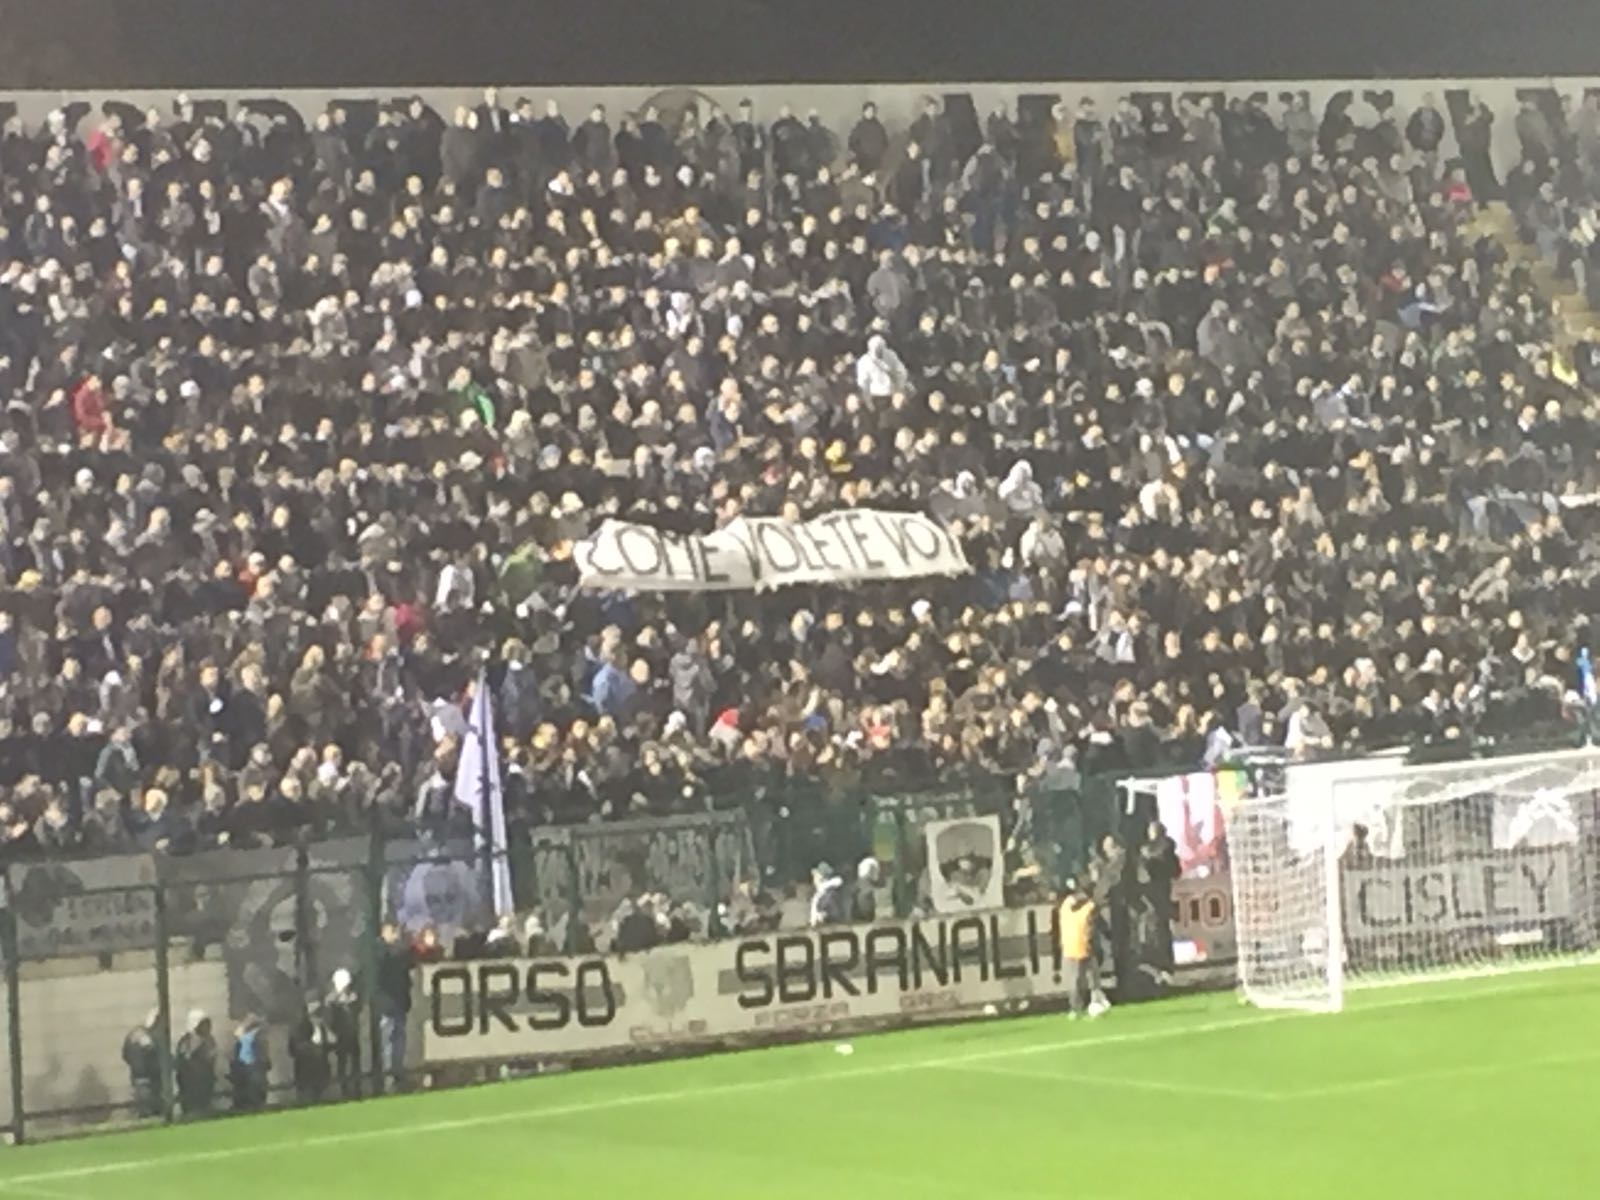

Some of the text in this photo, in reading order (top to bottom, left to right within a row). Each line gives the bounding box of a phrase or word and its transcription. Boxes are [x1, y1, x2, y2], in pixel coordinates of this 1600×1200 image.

[586, 525, 730, 582] COME
[737, 513, 884, 580] VOLETE
[1358, 860, 1556, 927] CISLEY
[431, 905, 1063, 1036] ORSO SBRANALI!
